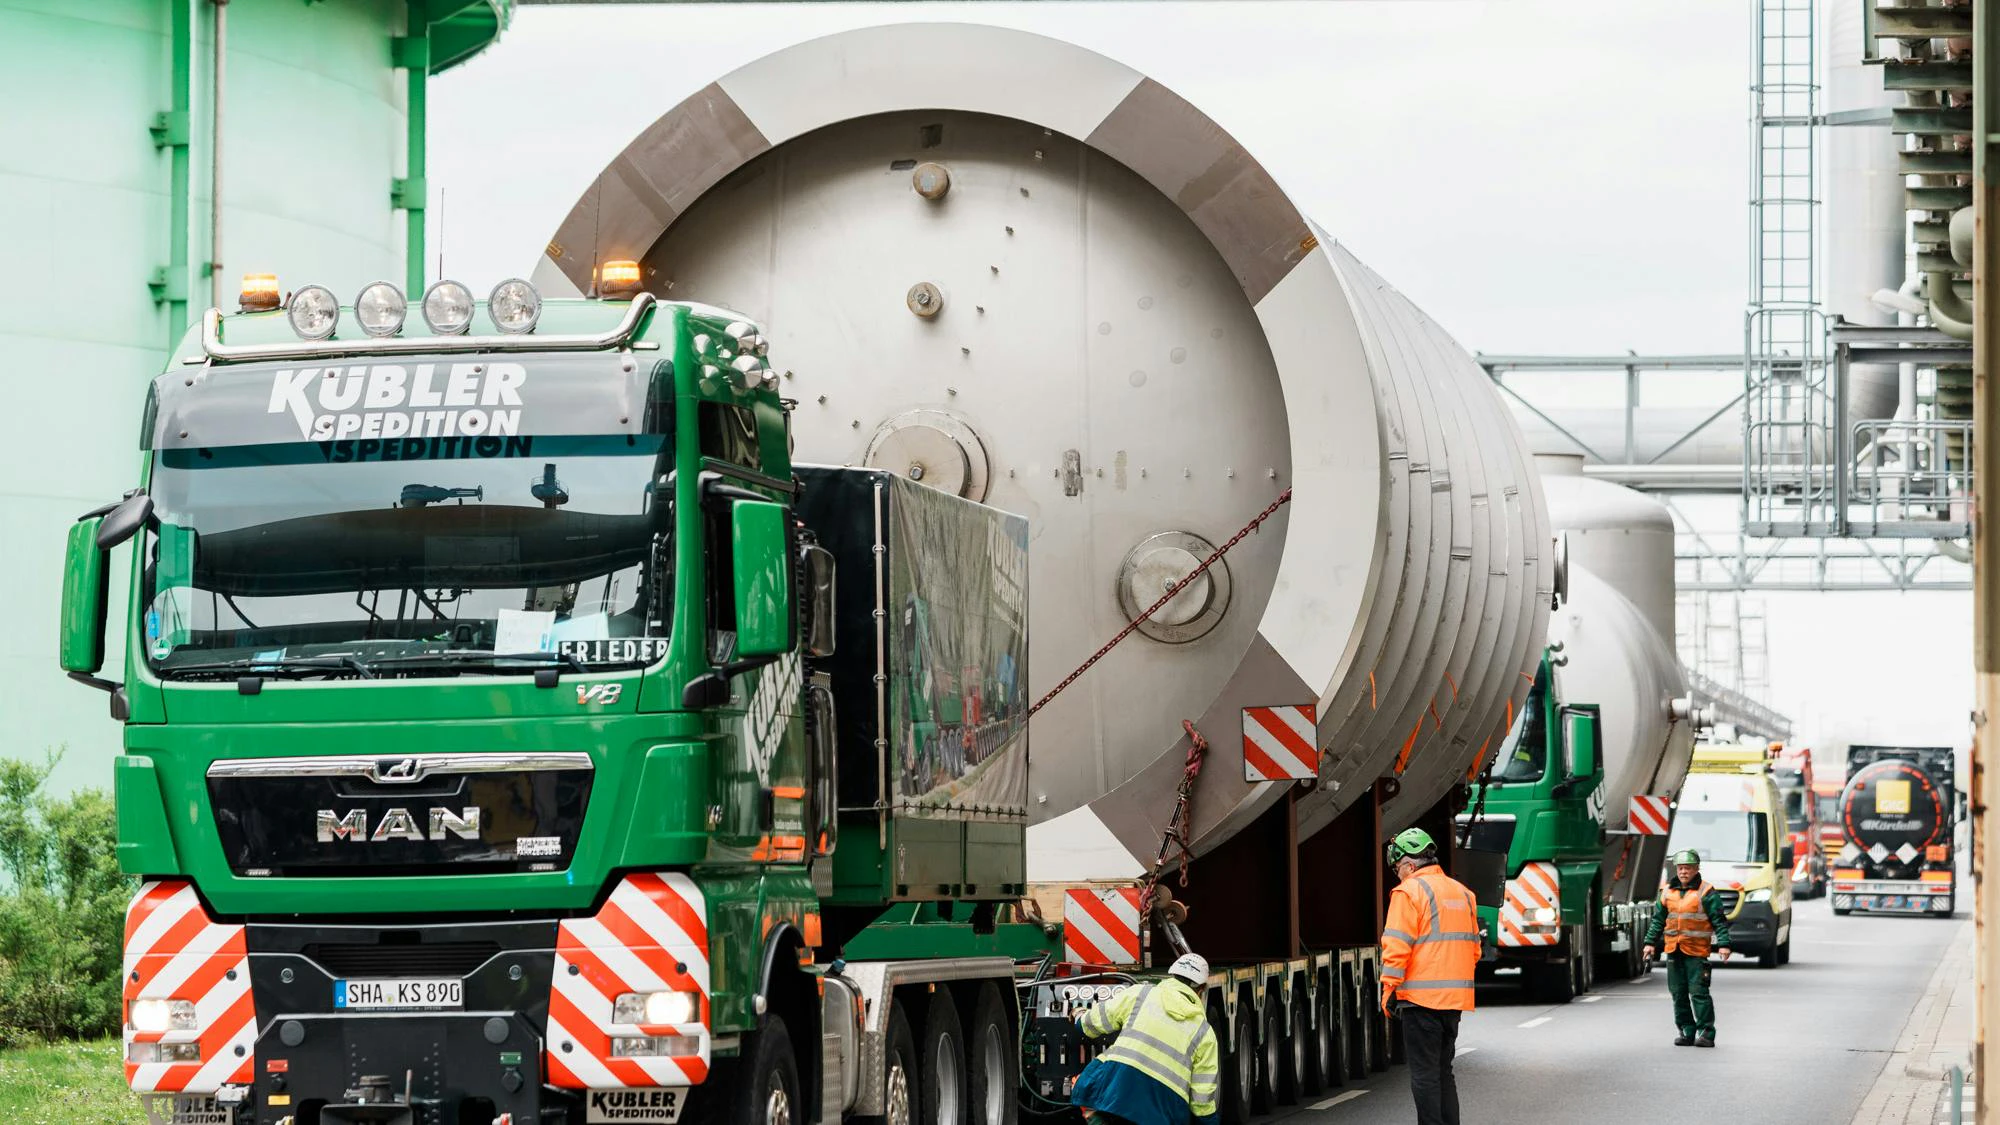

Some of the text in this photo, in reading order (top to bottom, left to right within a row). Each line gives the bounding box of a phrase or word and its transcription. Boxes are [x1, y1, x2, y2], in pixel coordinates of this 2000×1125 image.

[267, 363, 527, 441] KÜBLER
[310, 409, 521, 441] SPEDITION
[576, 683, 622, 705] V8
[317, 807, 480, 842] MAN
[349, 983, 383, 1003] SHA
[398, 983, 421, 1003] KS
[426, 982, 460, 1003] 890
[607, 1108, 675, 1119] SPEDITION
